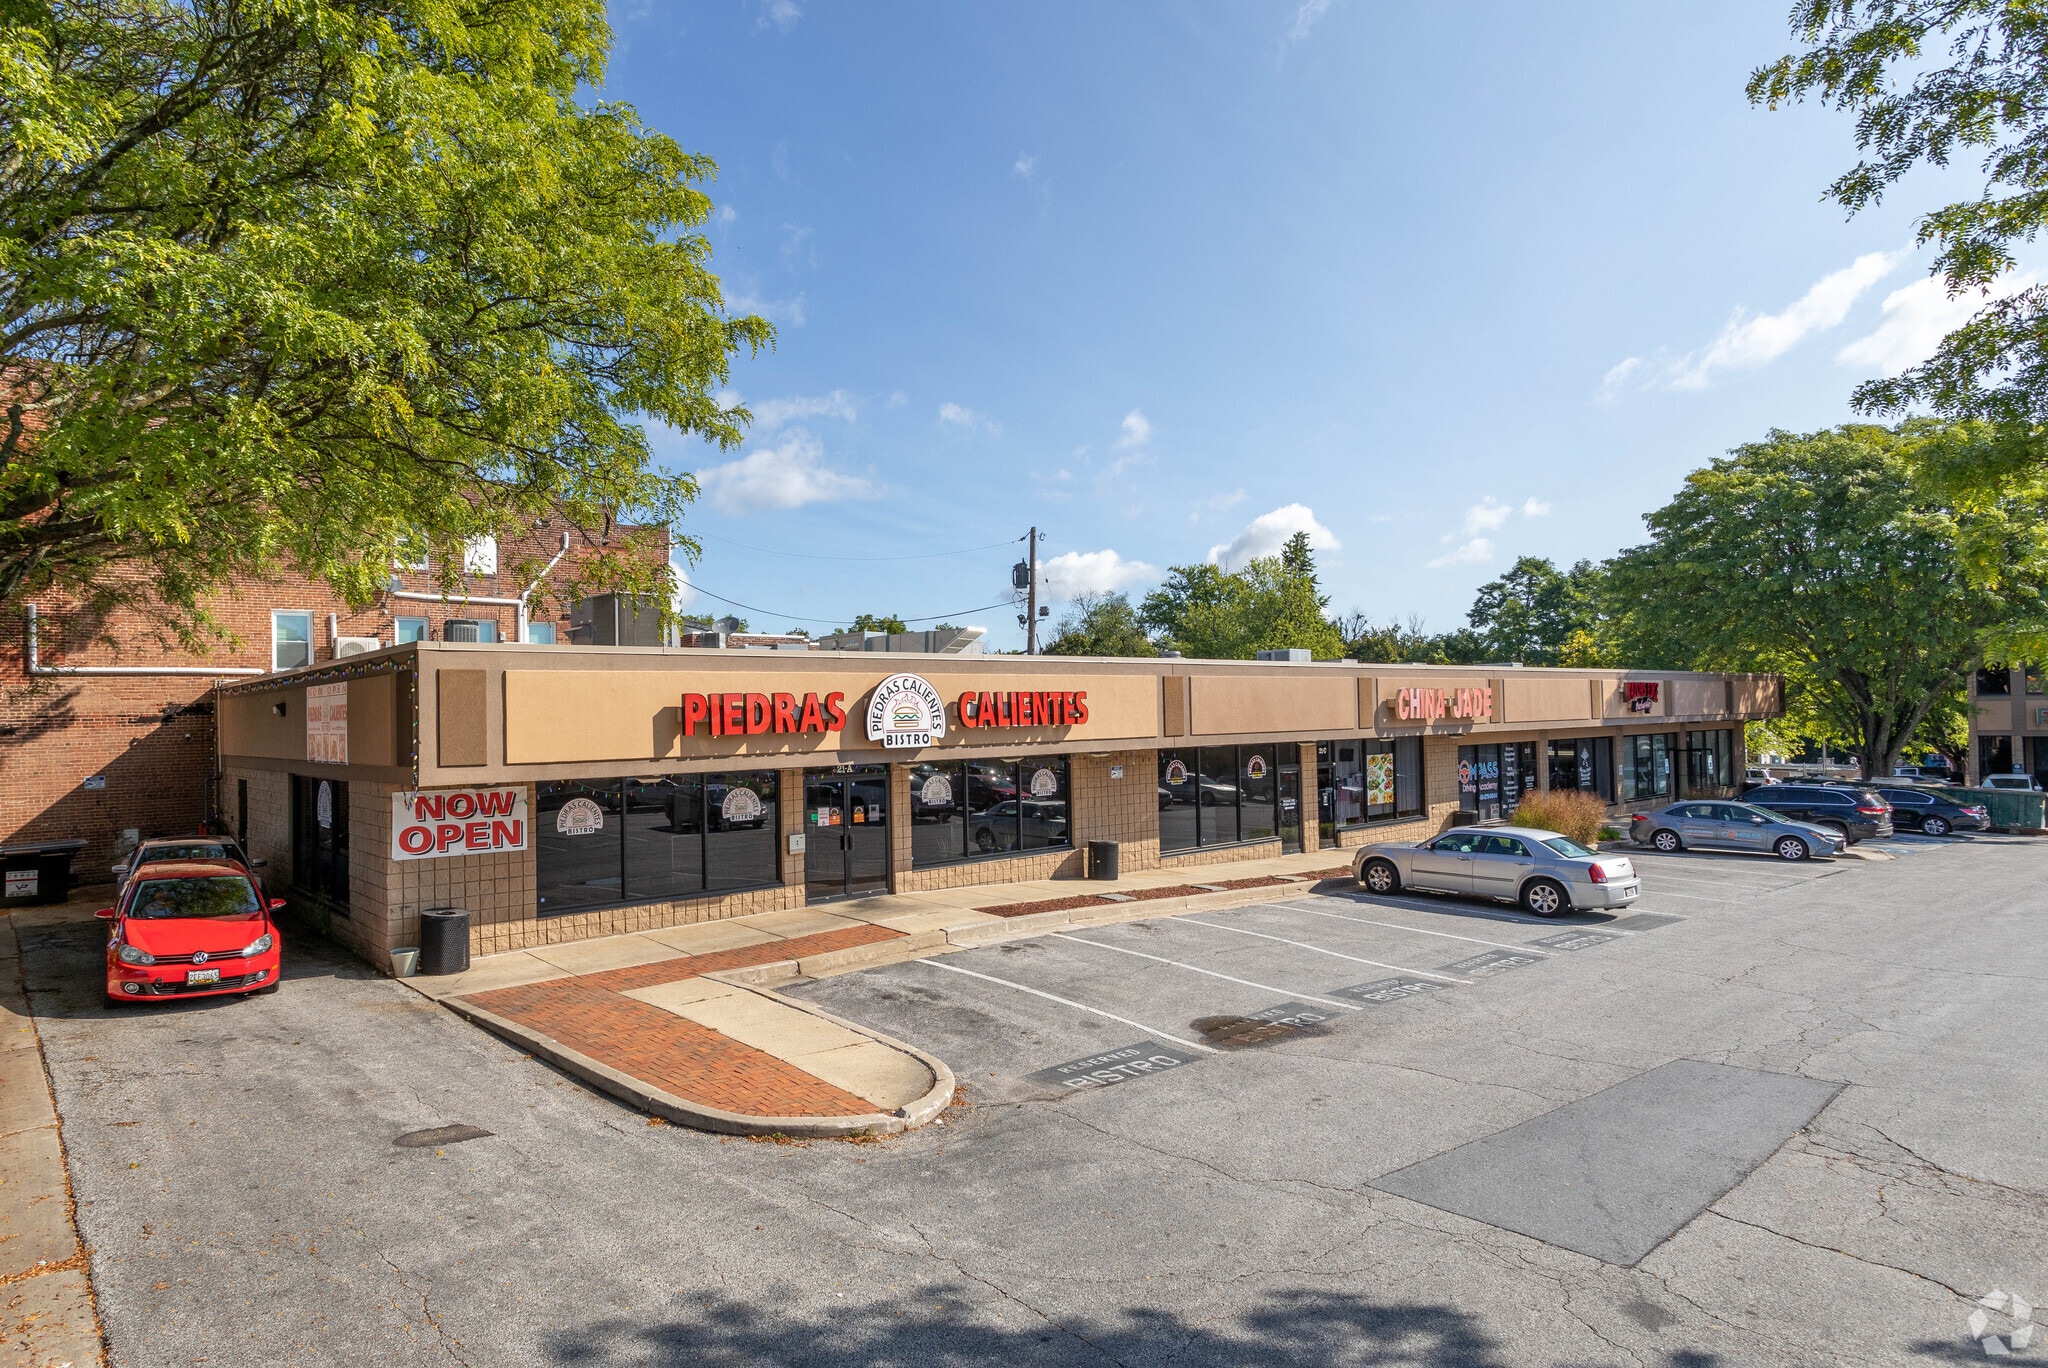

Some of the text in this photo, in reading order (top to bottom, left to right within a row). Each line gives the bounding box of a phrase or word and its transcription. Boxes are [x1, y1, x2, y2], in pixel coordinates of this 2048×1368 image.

[307, 683, 347, 697] NOW OPEN
[1395, 687, 1492, 720] CHINA JADE
[681, 691, 1089, 737] PIEDRAS CALIENTES
[872, 678, 942, 732] PIEDRAS CALIENTES
[886, 733, 930, 746] BISTRO
[836, 764, 853, 774] 21-A
[414, 791, 517, 822] NOW
[560, 801, 601, 829] PIEDRAS CALIENTES
[723, 790, 759, 815] PIEDRAS CALIENTES
[398, 819, 523, 855] OPEN
[567, 826, 594, 835] BISTRO
[1056, 1048, 1142, 1074] RESERVED
